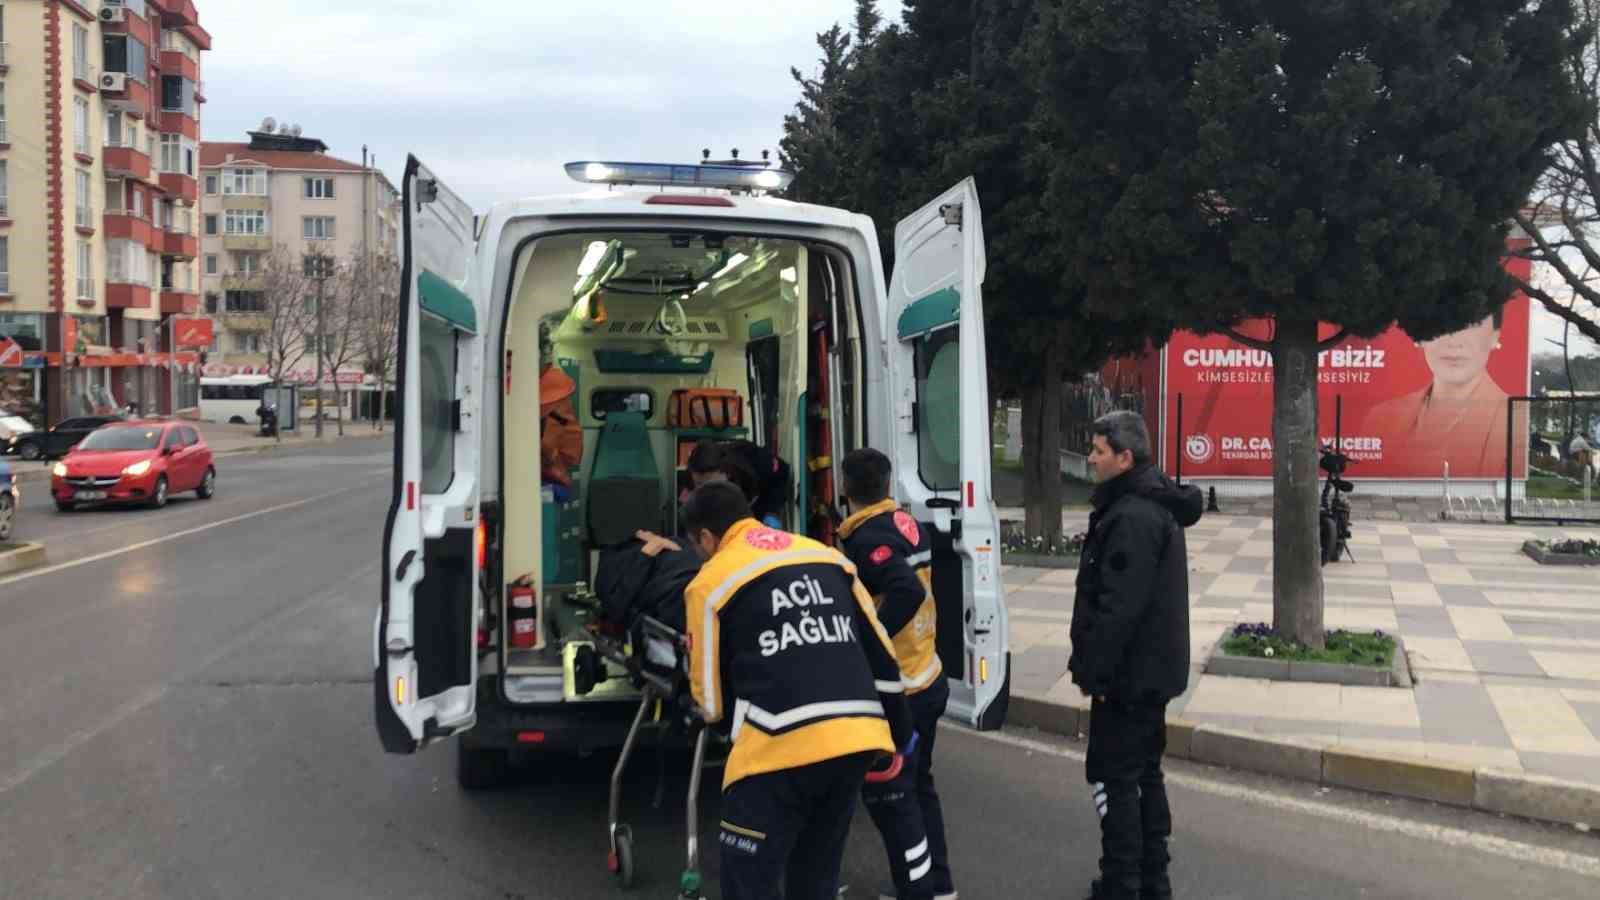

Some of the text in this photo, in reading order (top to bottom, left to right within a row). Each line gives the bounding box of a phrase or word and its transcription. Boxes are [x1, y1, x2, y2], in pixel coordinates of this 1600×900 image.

[1331, 345, 1385, 368] BİZİZ
[1197, 370, 1273, 383] KİMSESİZLE
[771, 574, 834, 616] ACİL
[758, 609, 857, 656] SAĞLIK
